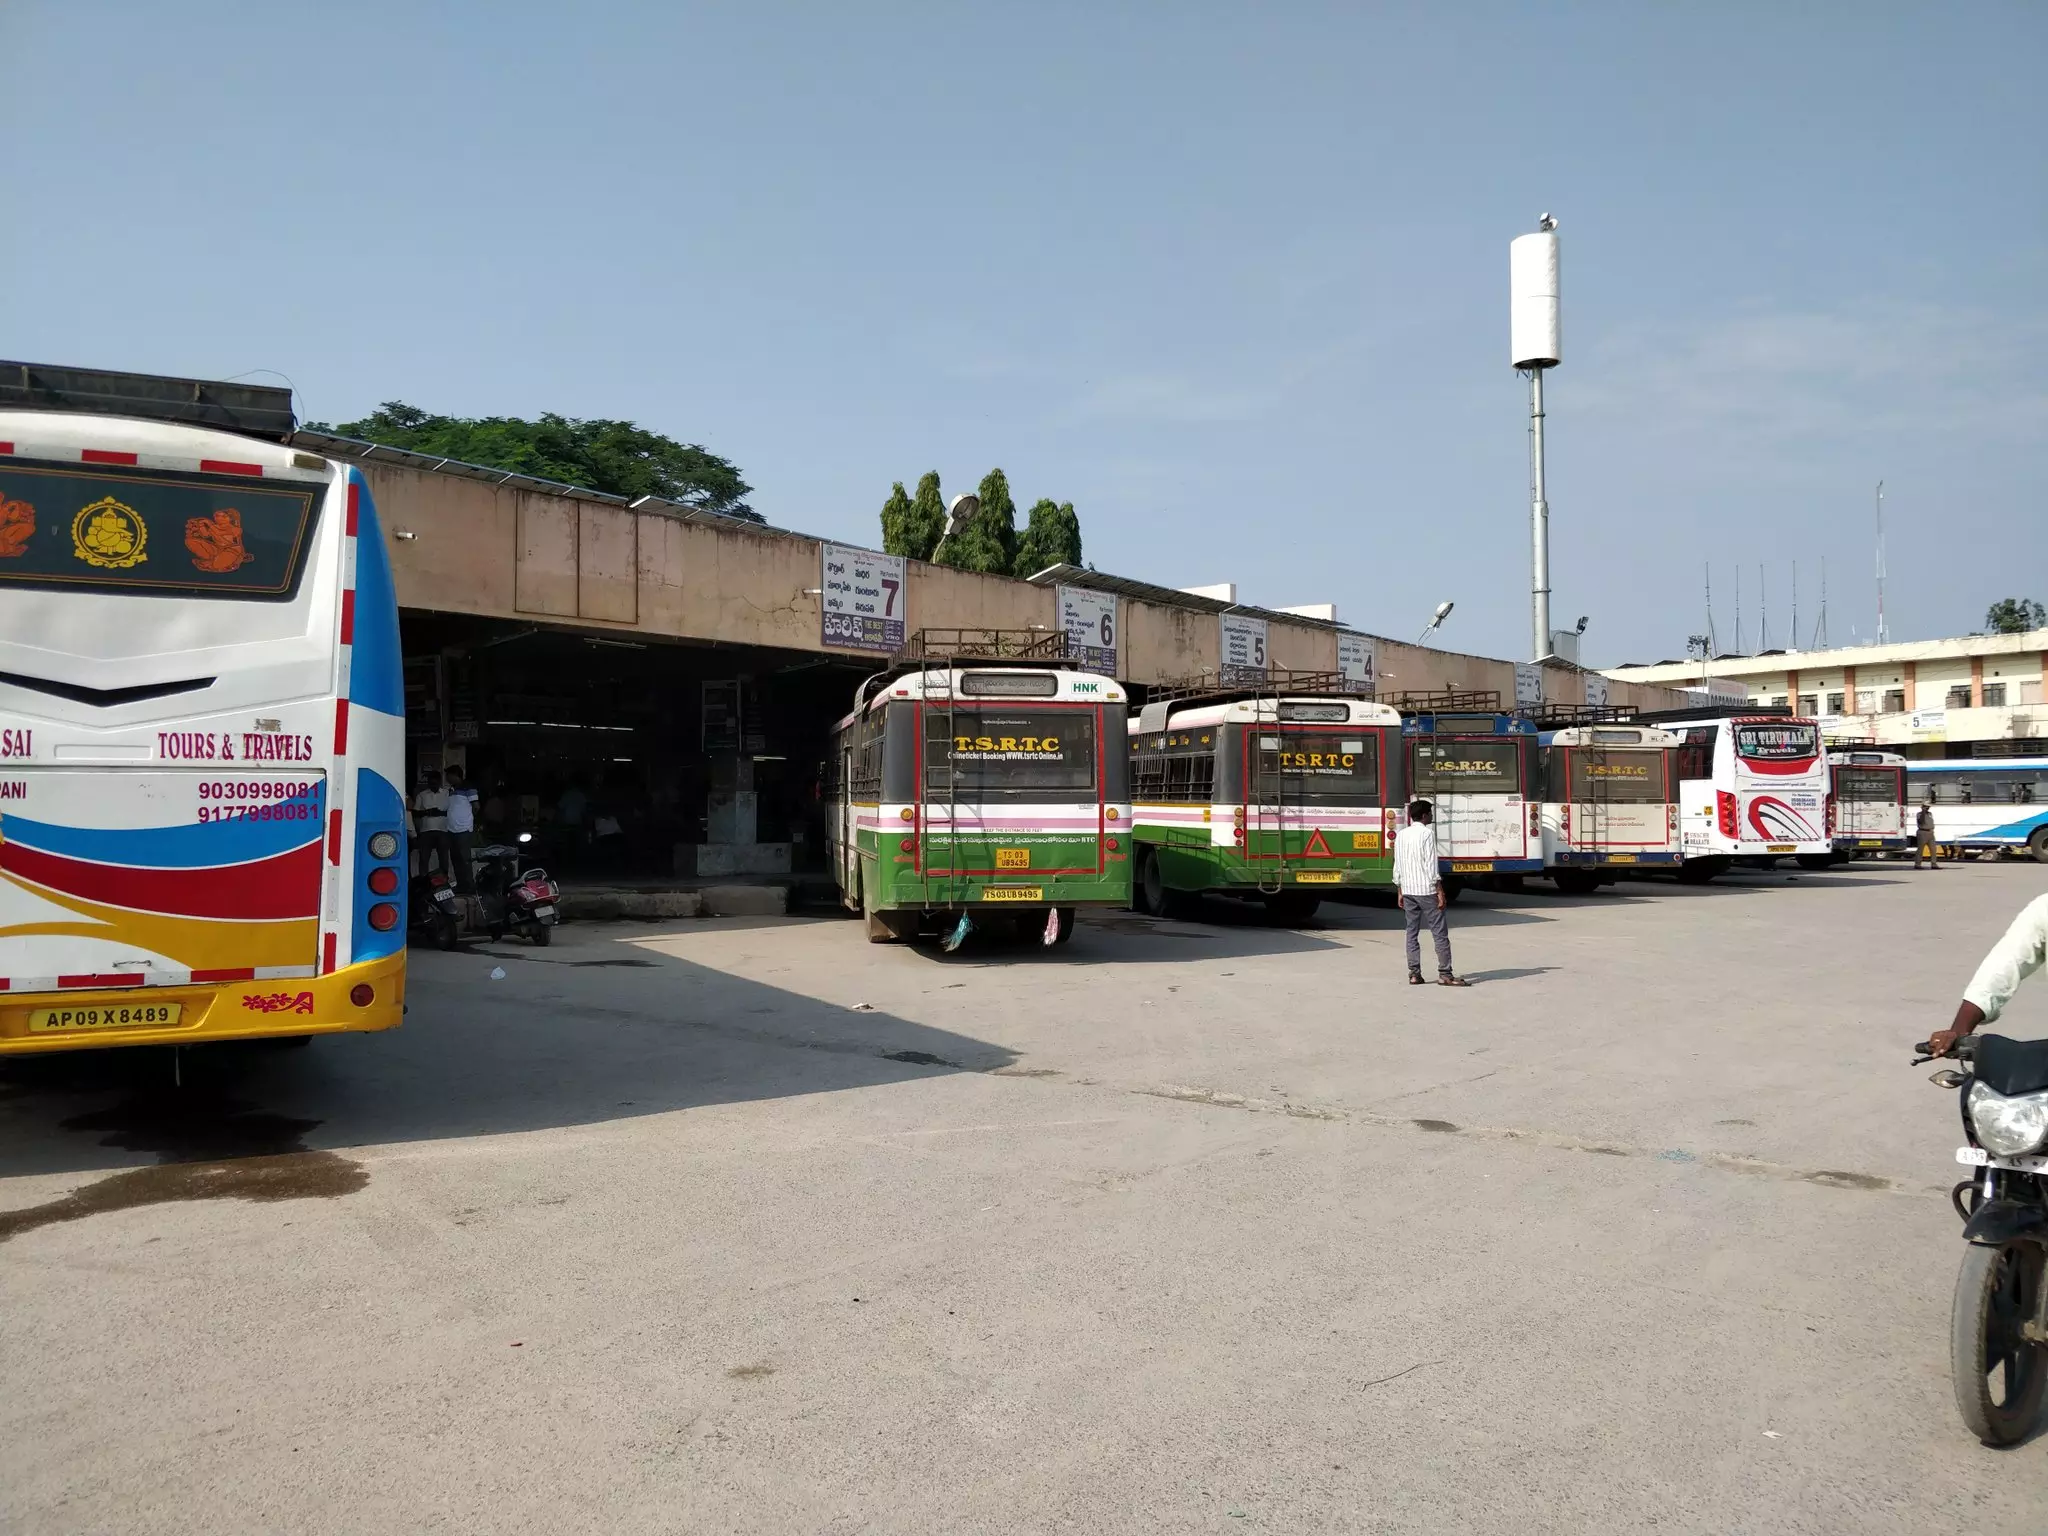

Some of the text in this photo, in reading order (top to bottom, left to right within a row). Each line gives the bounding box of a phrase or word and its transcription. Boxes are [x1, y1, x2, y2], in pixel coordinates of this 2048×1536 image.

[882, 579, 900, 616] 7
[1101, 614, 1112, 646] 6
[1255, 638, 1264, 666] 5
[1364, 655, 1373, 680] 4
[1073, 683, 1098, 692] HNK
[1535, 680, 1541, 701] 3
[1913, 718, 1920, 727] 5
[2, 729, 32, 758] SAI
[158, 733, 312, 761] TOURS & TRAVELS
[954, 737, 1060, 751] T.S.R.T.C
[1740, 732, 1811, 745] SRI TIRUMALA
[983, 752, 1005, 761] Booking
[1280, 753, 1354, 767] TSRTC
[1432, 761, 1497, 771] T.S.R.T.C
[1586, 766, 1648, 775] T.S.R.T.C
[0, 782, 26, 799] ANI
[199, 782, 319, 800] 9030998081
[198, 804, 319, 824] 9177998081
